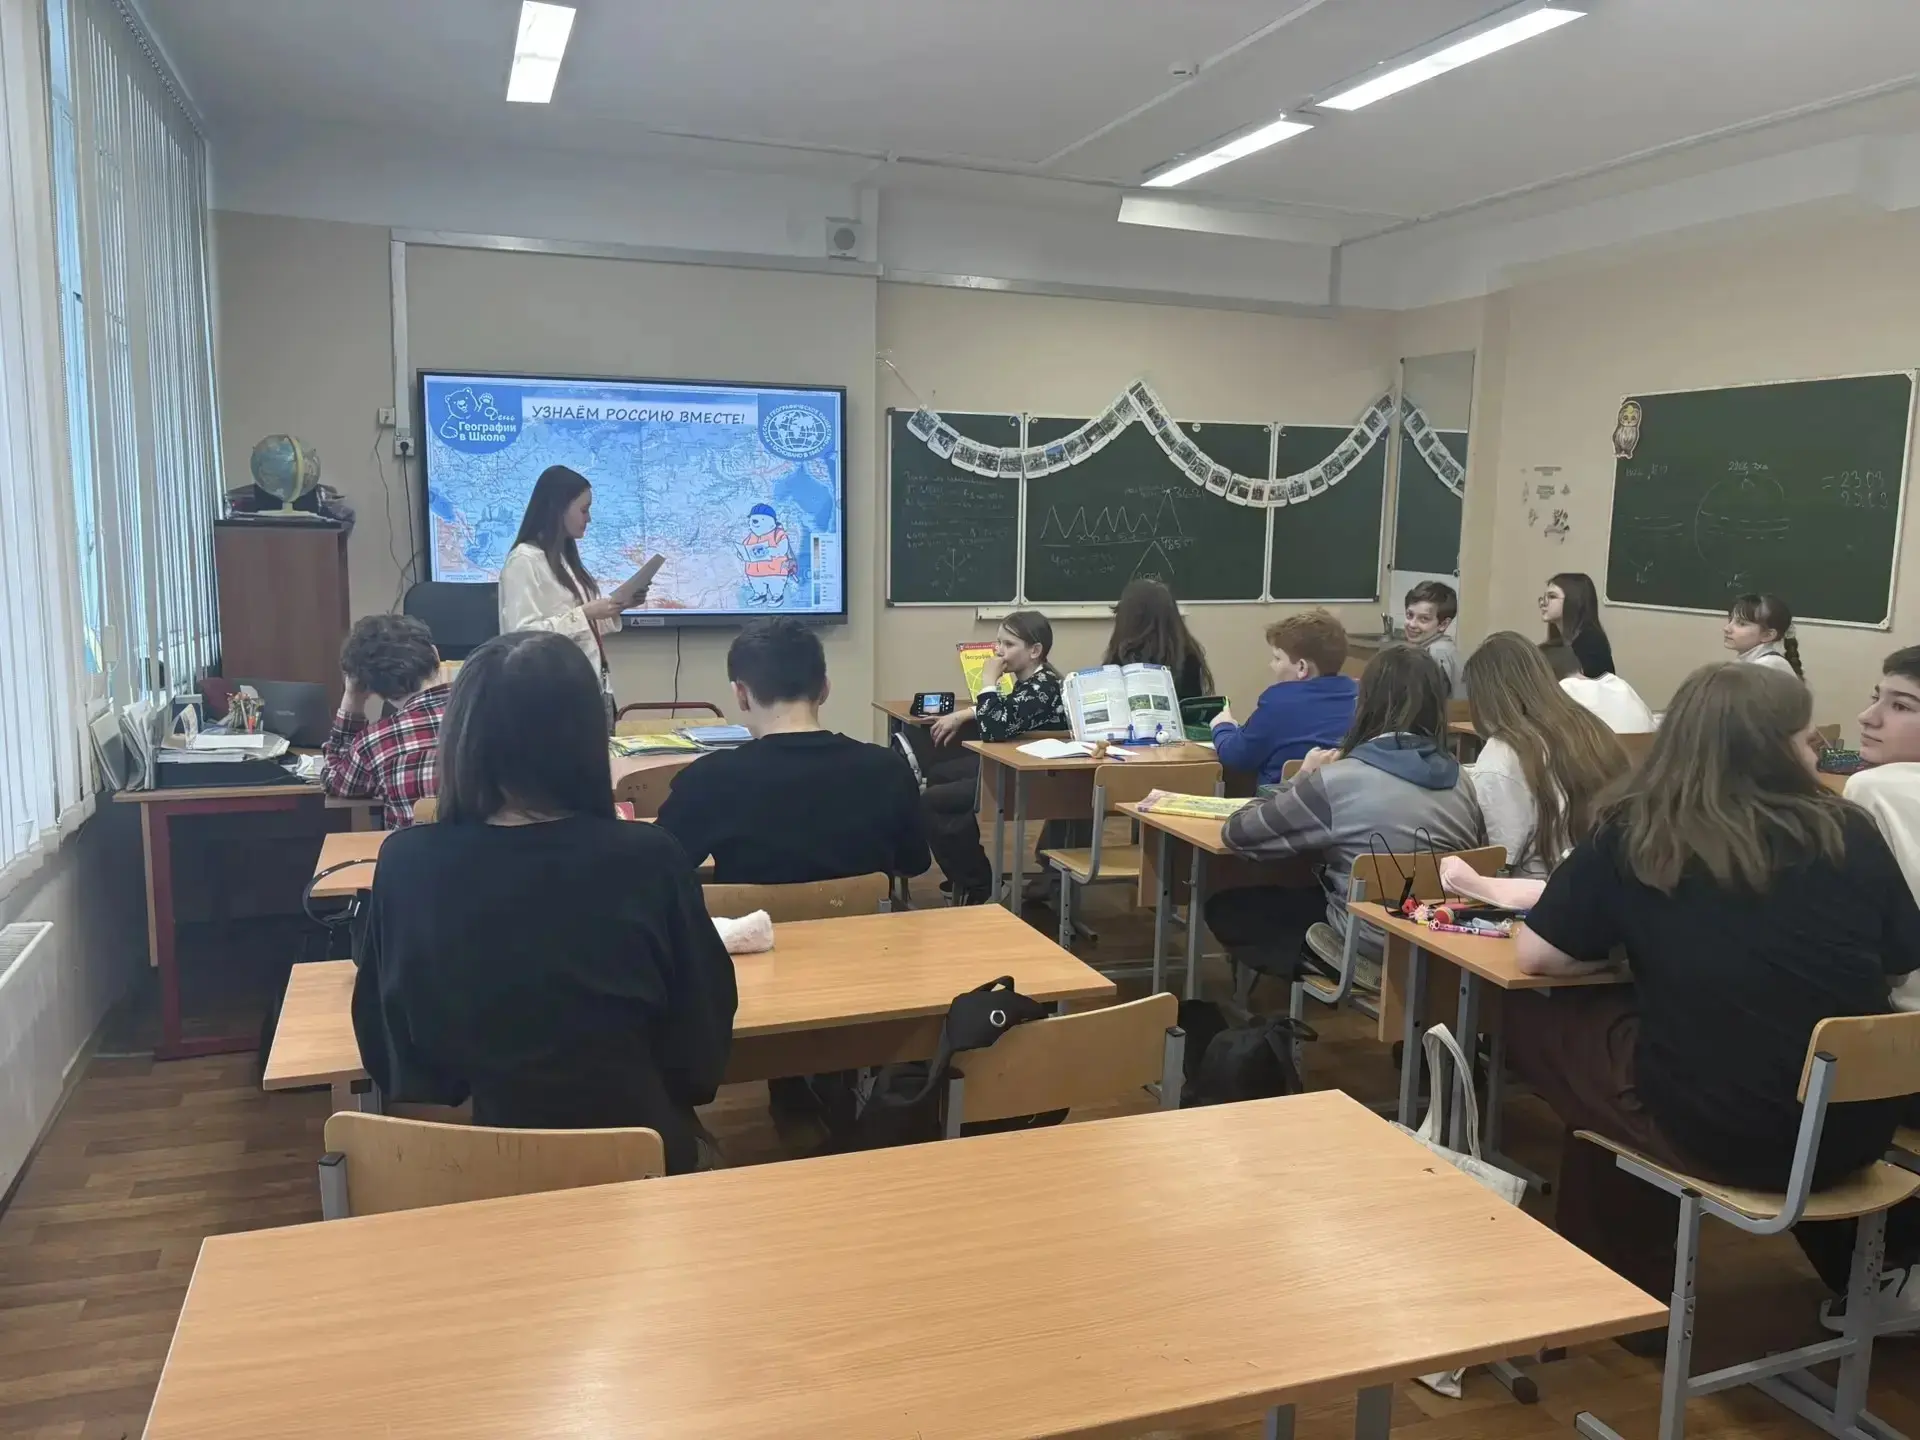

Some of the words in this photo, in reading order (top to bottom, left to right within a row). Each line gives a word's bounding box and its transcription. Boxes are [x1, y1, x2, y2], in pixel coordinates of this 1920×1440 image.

[532, 405, 599, 421] УЗНАЁМ
[606, 408, 674, 422] РОССИЮ
[680, 411, 745, 425] ВМЕСТЕ!
[458, 421, 517, 433] Географии
[468, 433, 506, 442] Школе
